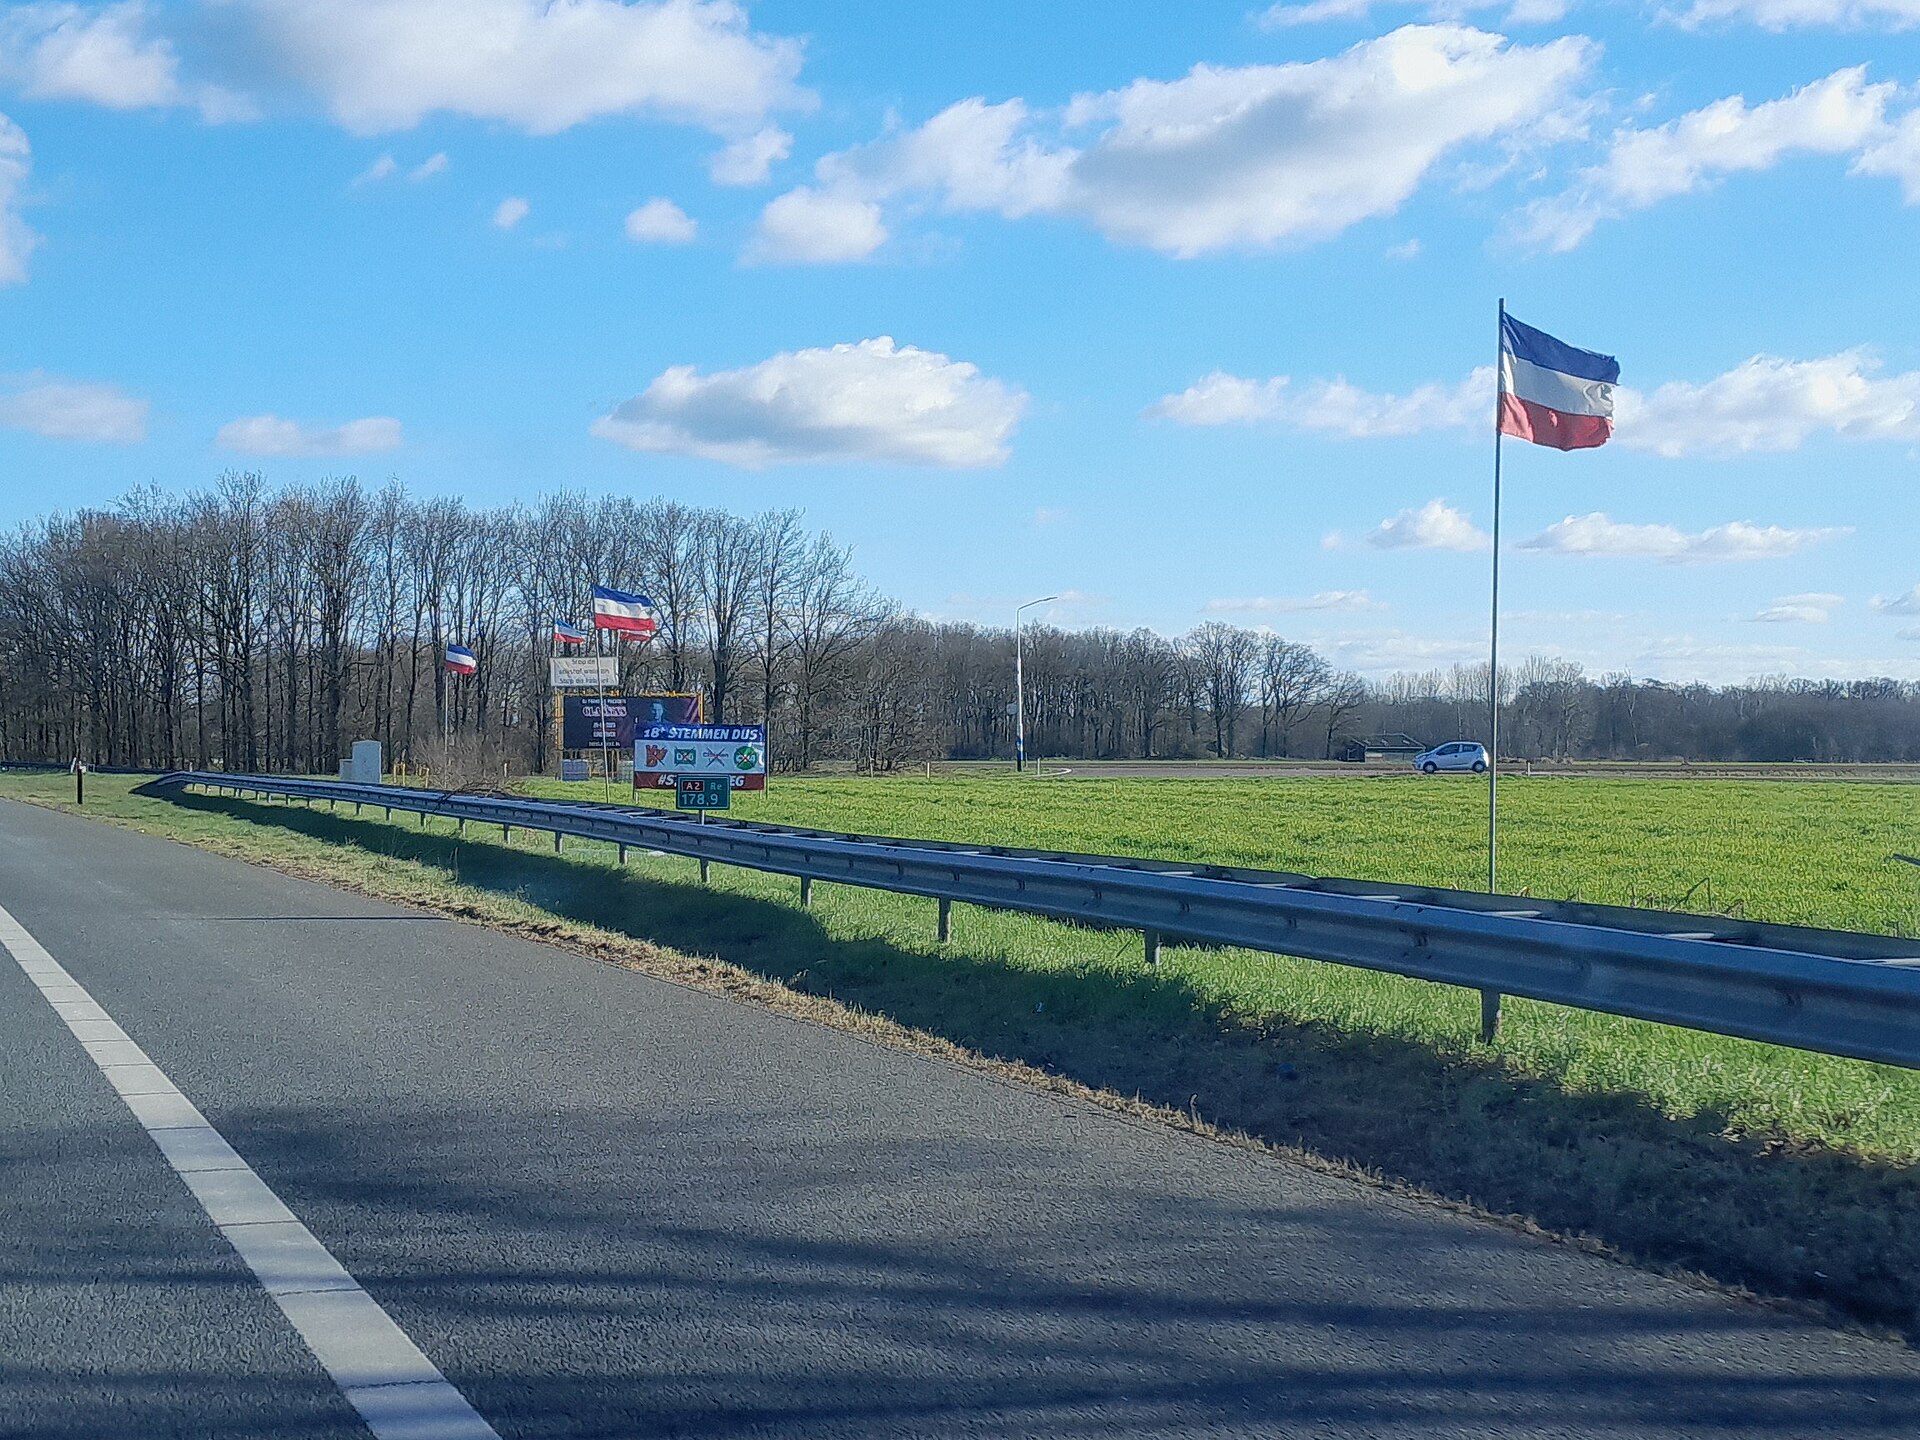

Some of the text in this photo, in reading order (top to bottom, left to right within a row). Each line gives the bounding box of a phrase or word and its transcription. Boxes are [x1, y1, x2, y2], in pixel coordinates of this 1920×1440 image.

[668, 726, 729, 740] STEMMEN
[731, 728, 758, 740] DUS
[710, 782, 722, 790] Re
[681, 793, 719, 806] 178,9
